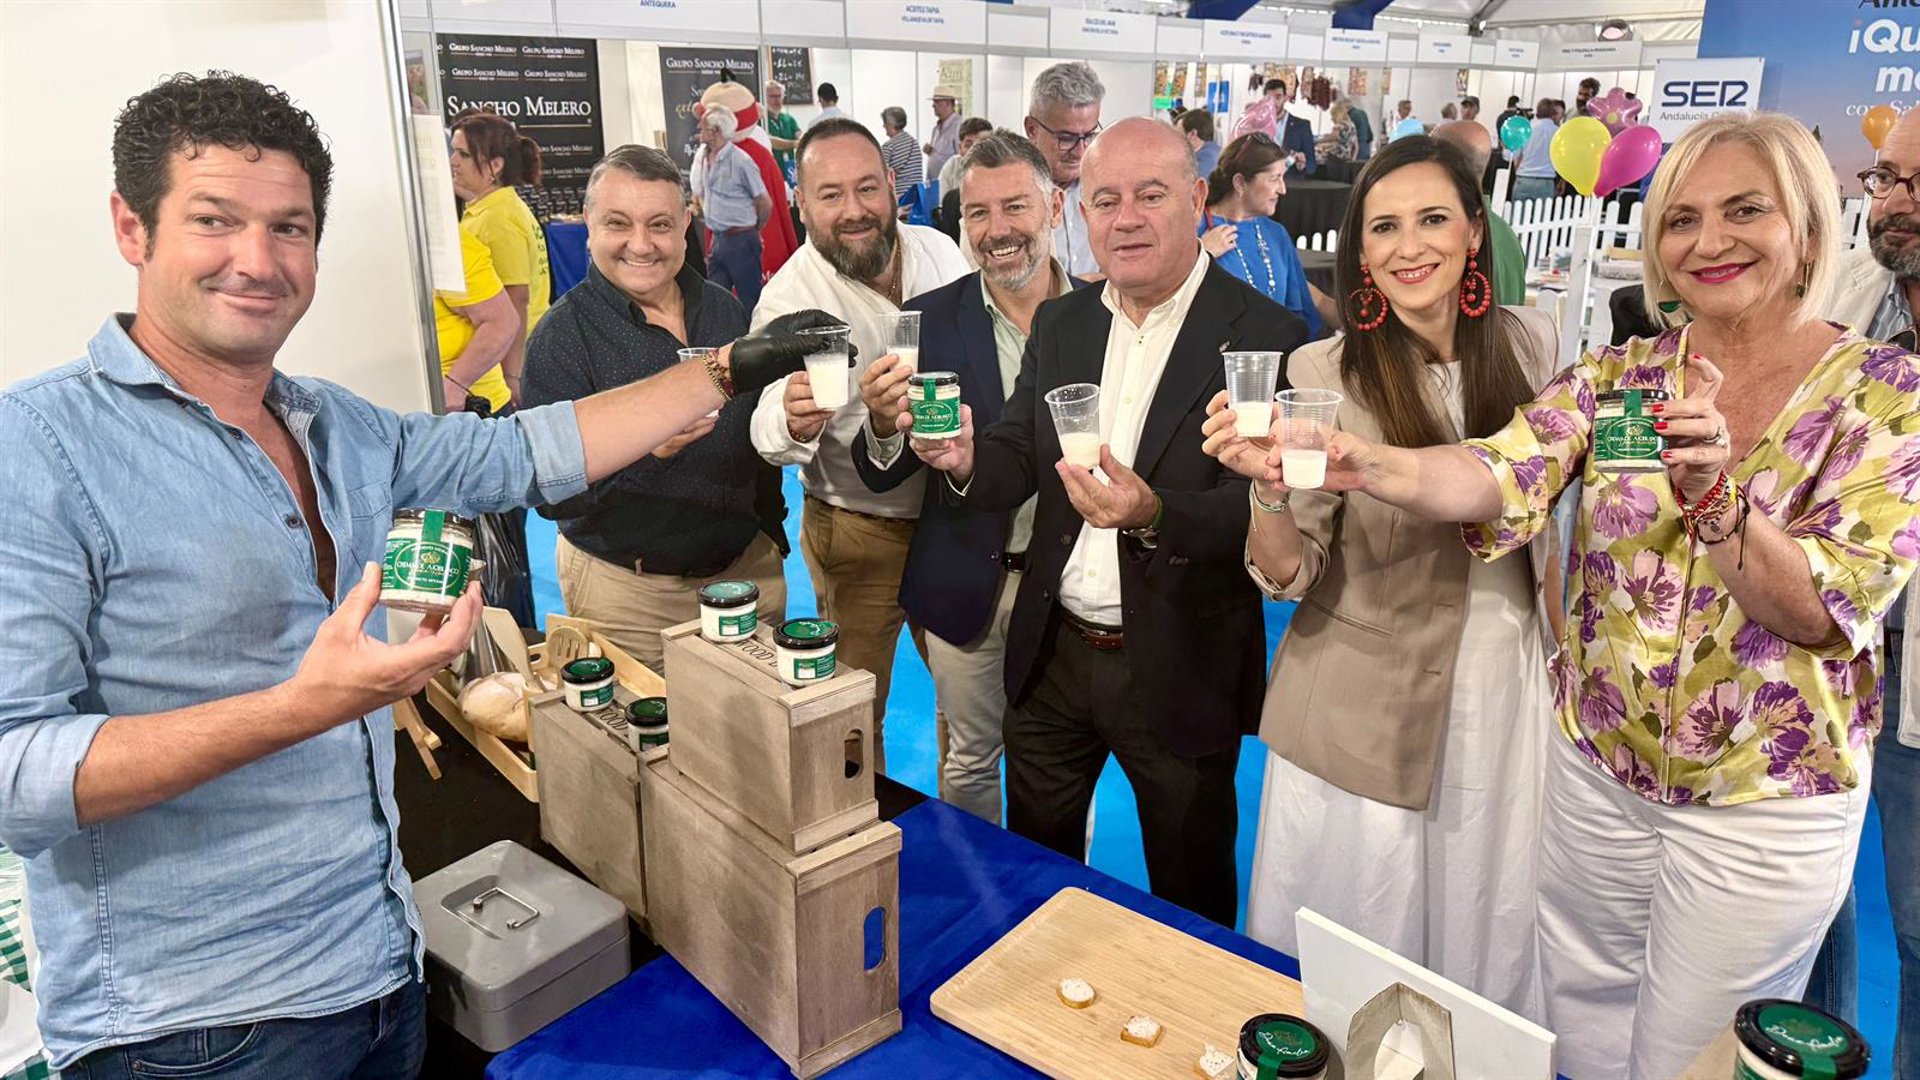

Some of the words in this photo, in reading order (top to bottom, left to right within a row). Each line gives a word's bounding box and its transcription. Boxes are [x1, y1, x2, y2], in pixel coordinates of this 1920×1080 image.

[666, 57, 693, 69] GRUPO
[694, 58, 725, 69] SANCHO
[726, 58, 754, 69] MELERO
[1661, 80, 1749, 107] SER
[524, 96, 592, 116] MELERO
